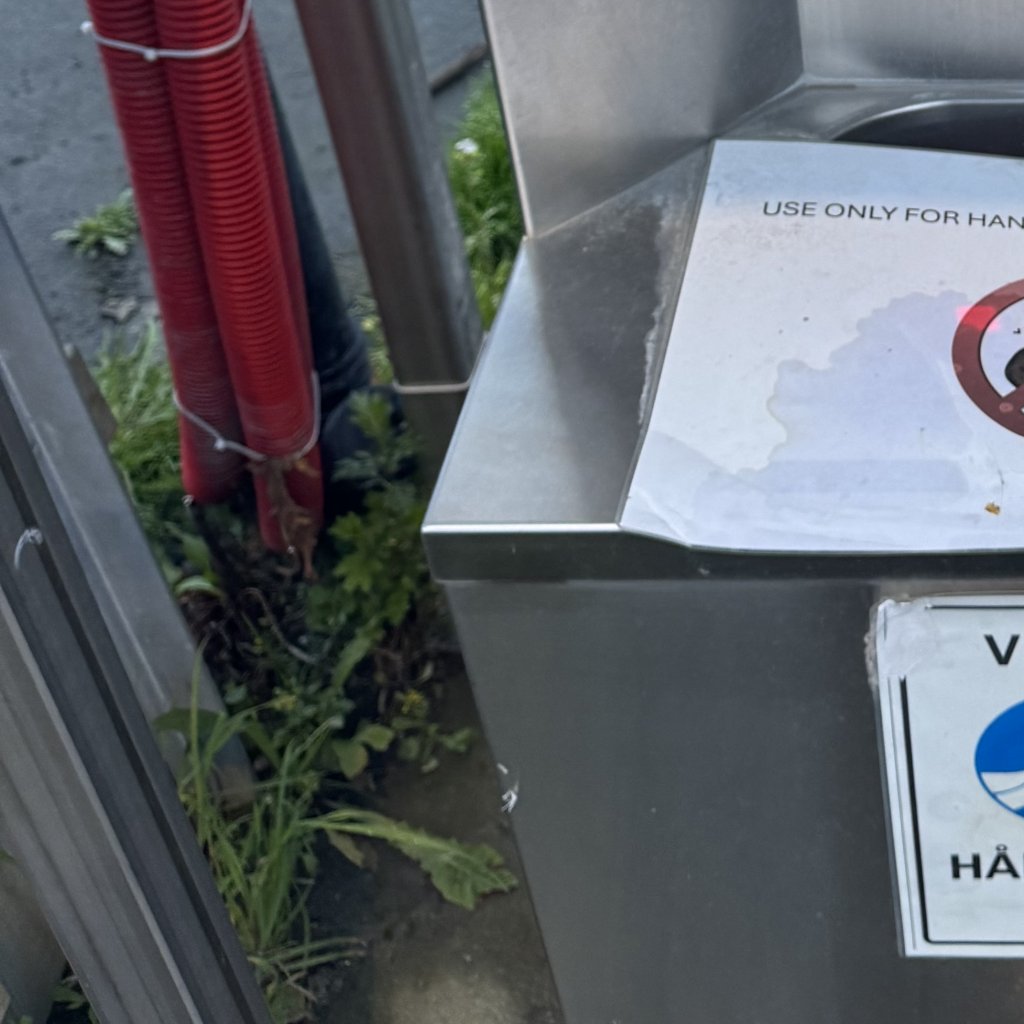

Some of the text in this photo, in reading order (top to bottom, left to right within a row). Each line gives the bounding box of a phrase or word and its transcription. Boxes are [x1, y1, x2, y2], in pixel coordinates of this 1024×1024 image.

[763, 202, 816, 216] USE
[825, 203, 897, 220] ONLY
[905, 208, 959, 225] FOR
